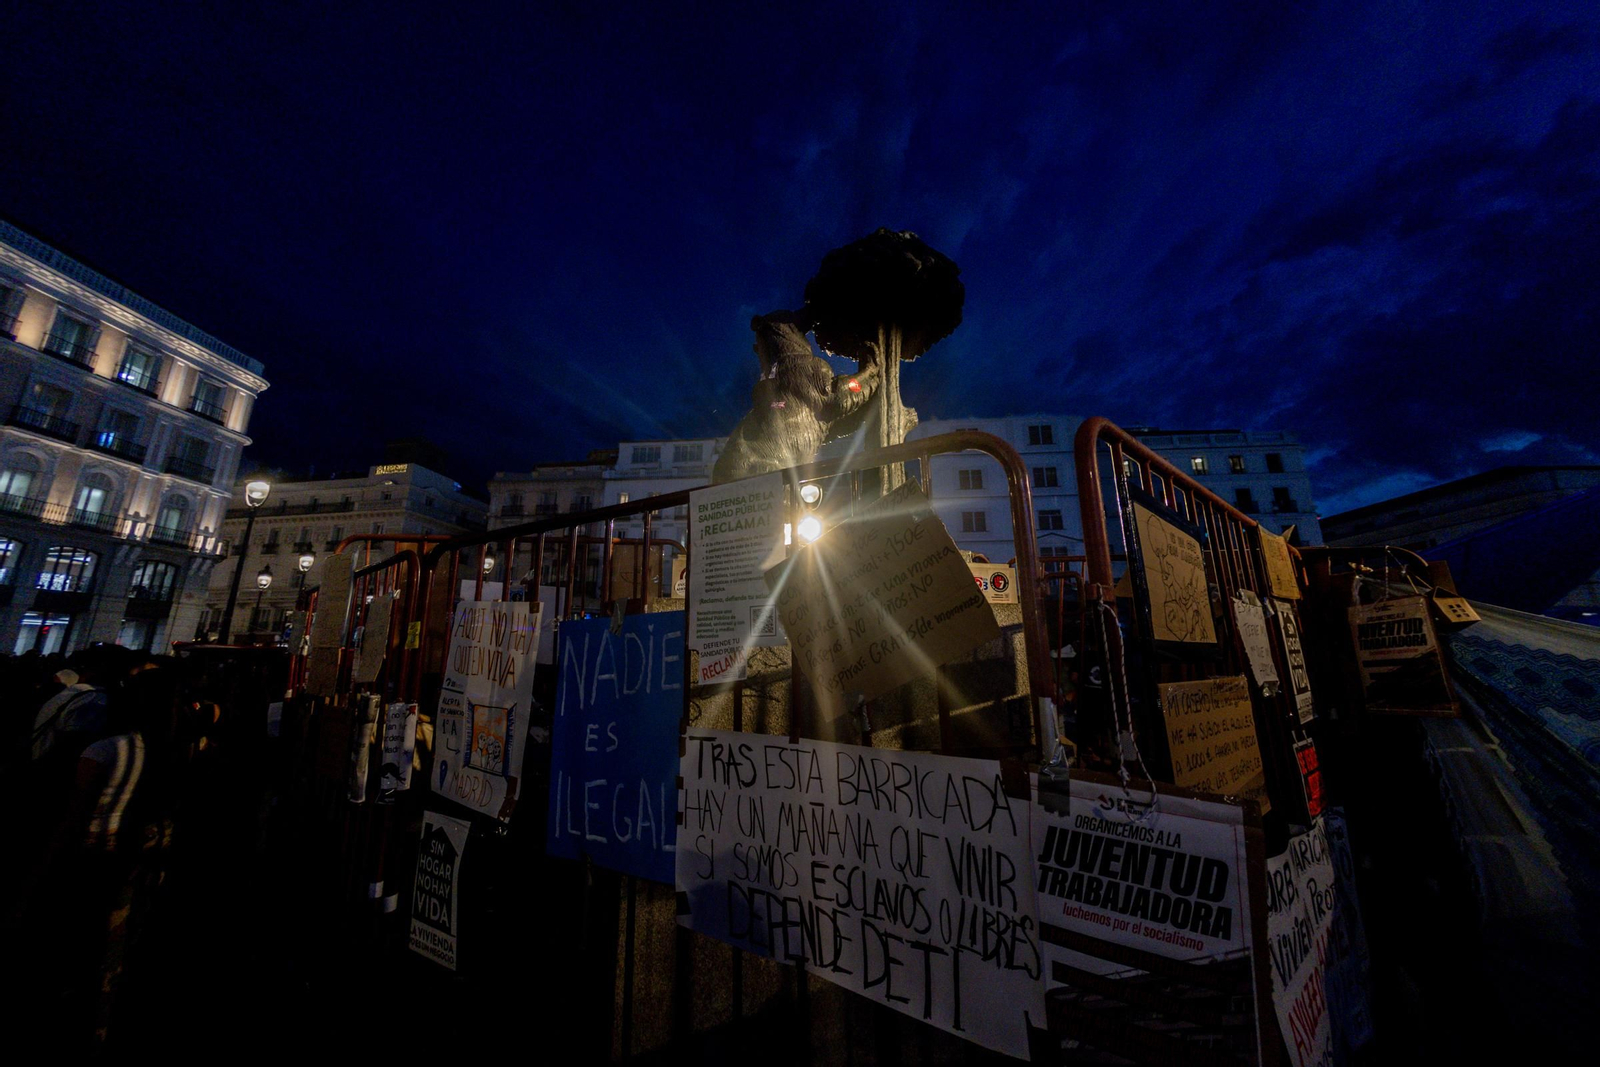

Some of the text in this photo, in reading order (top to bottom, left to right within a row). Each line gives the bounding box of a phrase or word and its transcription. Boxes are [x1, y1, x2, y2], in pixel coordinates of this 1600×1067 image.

[698, 491, 775, 513] EN DEFENSA DE LA
[698, 502, 773, 523] SANIDAD PÚBLICA
[700, 514, 770, 540] ¡RECLAMA!
[797, 604, 857, 647] Calefaccón:
[908, 546, 956, 577] manta
[849, 619, 866, 644] NO
[911, 574, 934, 598] NO
[937, 594, 985, 624] momento)
[455, 608, 486, 643] AQUI
[490, 607, 507, 647] NO
[508, 611, 537, 655] HAY
[703, 637, 740, 650] DEFIENDE TU
[1357, 617, 1423, 640] JUVENTUD
[453, 645, 516, 690] QUIEN VIVA
[700, 649, 723, 658] SANIDAD
[701, 651, 746, 681] RECLAMA
[1167, 693, 1180, 718] MI
[584, 721, 619, 752] ES
[1171, 729, 1184, 745] ME
[1175, 760, 1183, 777] A
[449, 771, 493, 807] MADRID
[689, 737, 1017, 836] TRAS ESTA BARRICADA
[555, 770, 676, 853] ILEGAL
[684, 789, 727, 833] HAY
[737, 795, 766, 843] UN
[777, 801, 881, 869] MAÑANA
[890, 824, 939, 882] QUE
[1075, 814, 1181, 849] ORGANICEMOS A LA
[430, 840, 445, 857] SIN
[420, 853, 451, 881] HOGAR
[1038, 826, 1229, 903] JUVENTUD
[418, 873, 450, 899] NO HAY
[416, 890, 449, 928] VIDA
[696, 834, 715, 880] SI
[734, 841, 799, 890] SOMOS
[810, 859, 932, 936] ESCLAVOS
[939, 898, 952, 945] O
[954, 898, 1041, 981] LIBRES
[1038, 864, 1232, 940] TRABAJADORA
[418, 927, 454, 954] VIVIENDA
[1063, 902, 1111, 927] luchemos
[1112, 916, 1129, 933] por
[1132, 921, 1142, 935] el
[1143, 926, 1204, 952] socialismo
[861, 917, 911, 1005] DE
[905, 939, 966, 1033] TI
